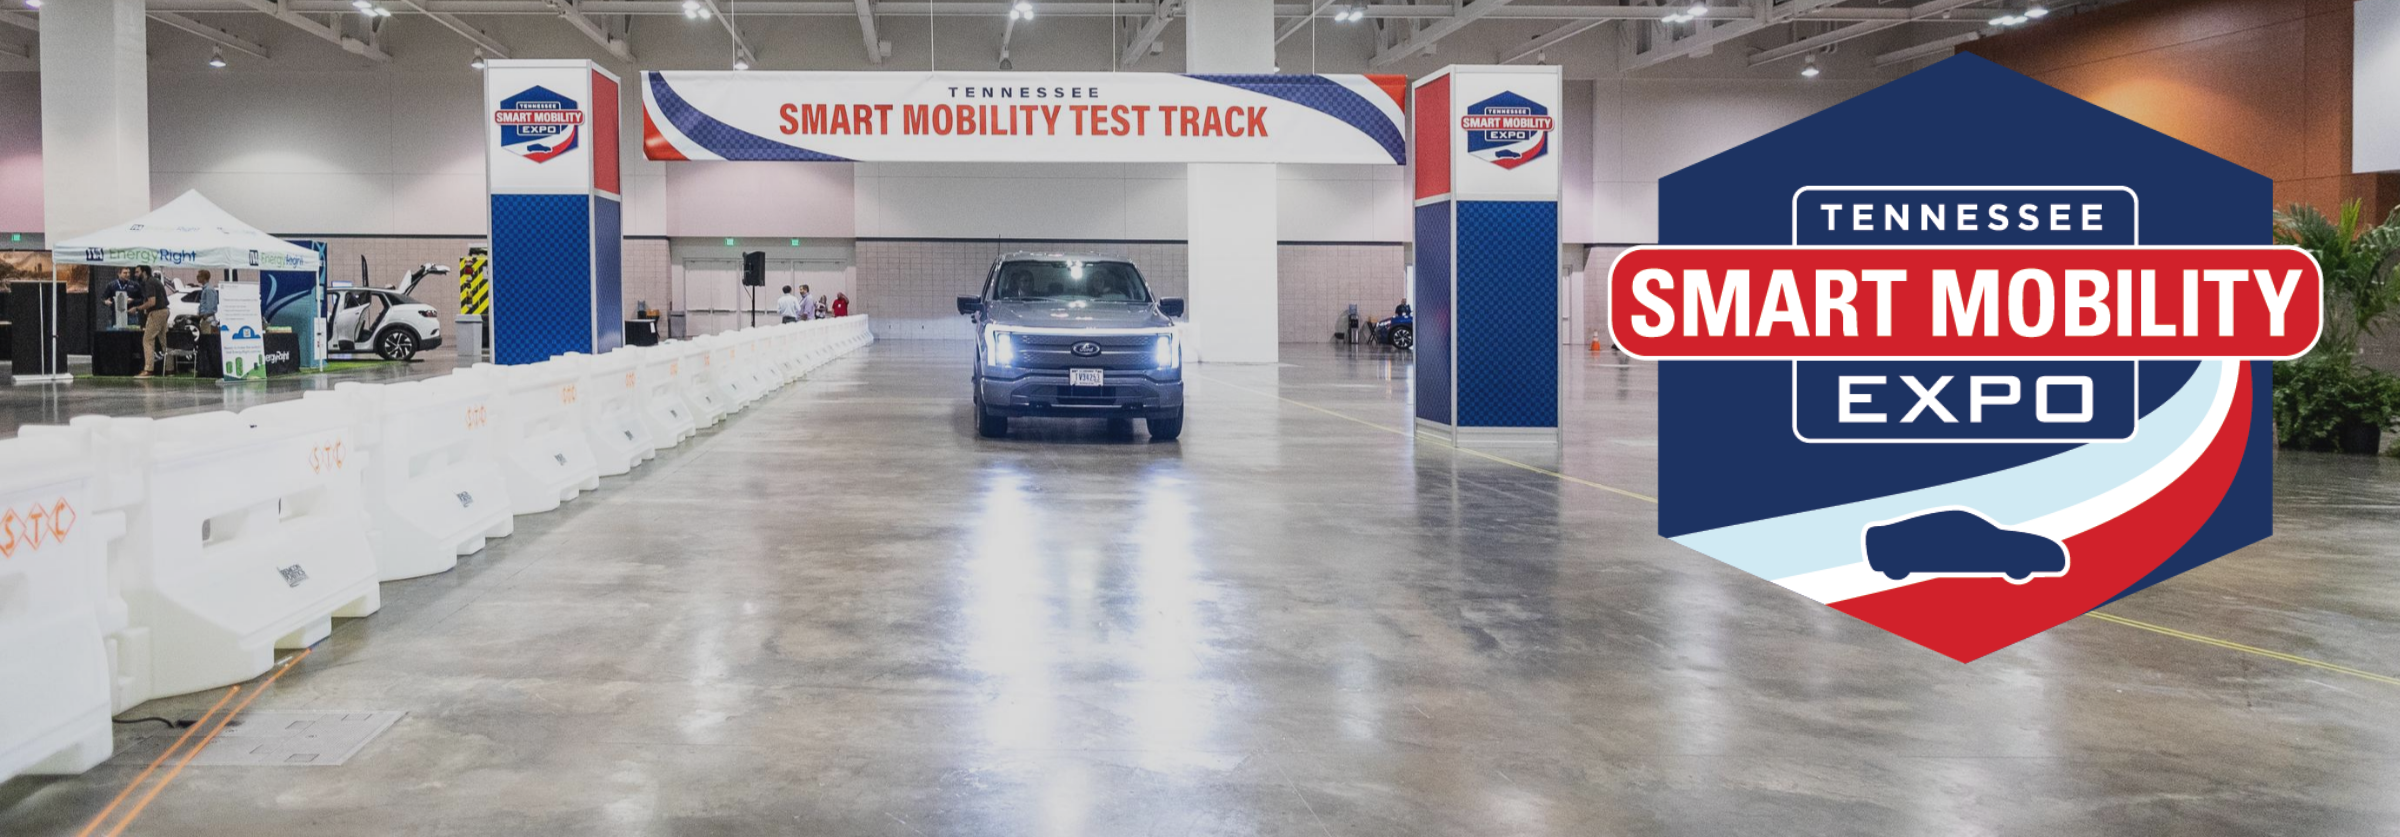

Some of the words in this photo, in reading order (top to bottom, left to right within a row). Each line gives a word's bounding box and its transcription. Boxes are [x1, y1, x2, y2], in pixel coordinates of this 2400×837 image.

[949, 86, 1099, 98] TENNESSEE
[496, 111, 533, 123] SMART
[534, 111, 582, 123] MOBILITY
[780, 103, 893, 135] SMART
[904, 104, 1061, 136] MOBILITY
[1070, 105, 1150, 136] TEST
[1159, 105, 1267, 137] TRACK
[1462, 117, 1501, 128] SMART
[1502, 117, 1552, 128] MOBILITY
[522, 125, 557, 134] EXPO
[1490, 131, 1526, 139] EXPO
[109, 248, 196, 264] EnergyRight
[4, 501, 66, 551] STC
